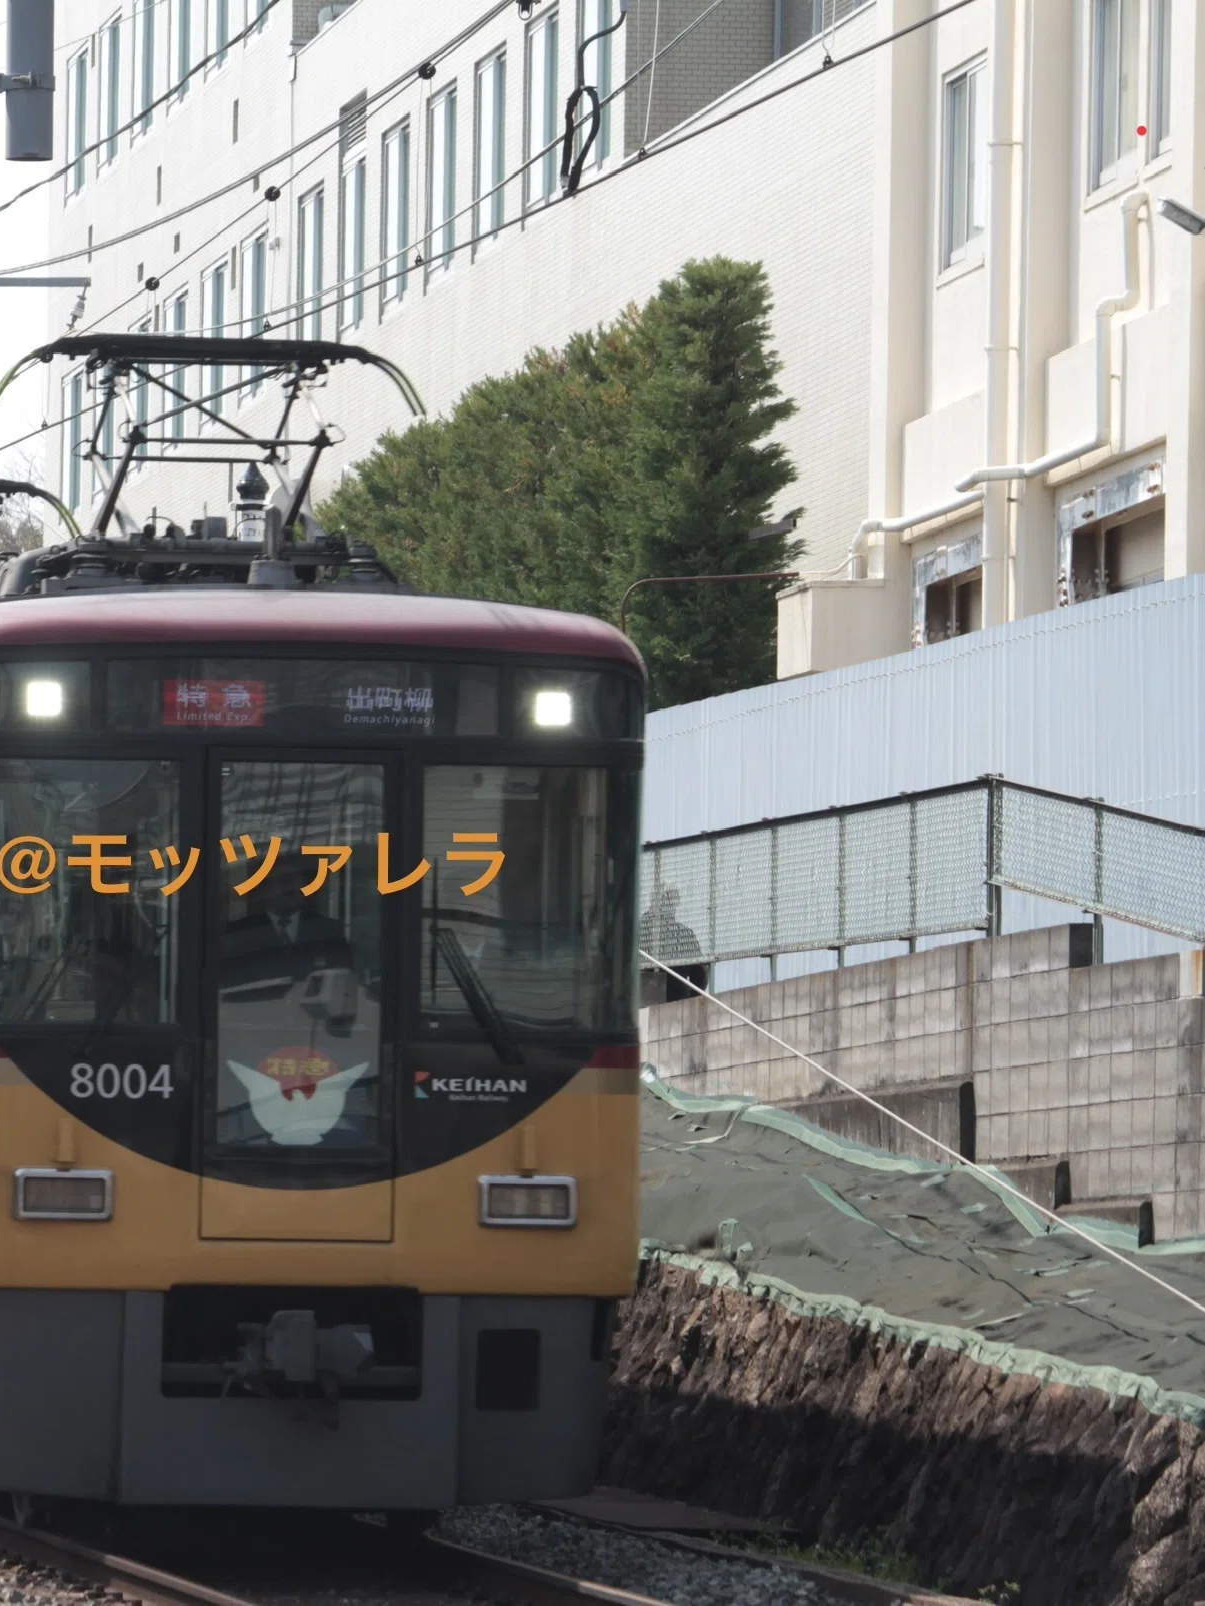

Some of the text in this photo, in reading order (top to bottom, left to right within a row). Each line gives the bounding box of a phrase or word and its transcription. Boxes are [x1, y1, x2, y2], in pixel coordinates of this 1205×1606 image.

[346, 686, 434, 712] 出町柳
[176, 711, 222, 721] Limited
[343, 713, 436, 727] Demachiyanagi
[70, 1062, 174, 1099] 8004
[431, 1076, 527, 1093] KEIHAN
